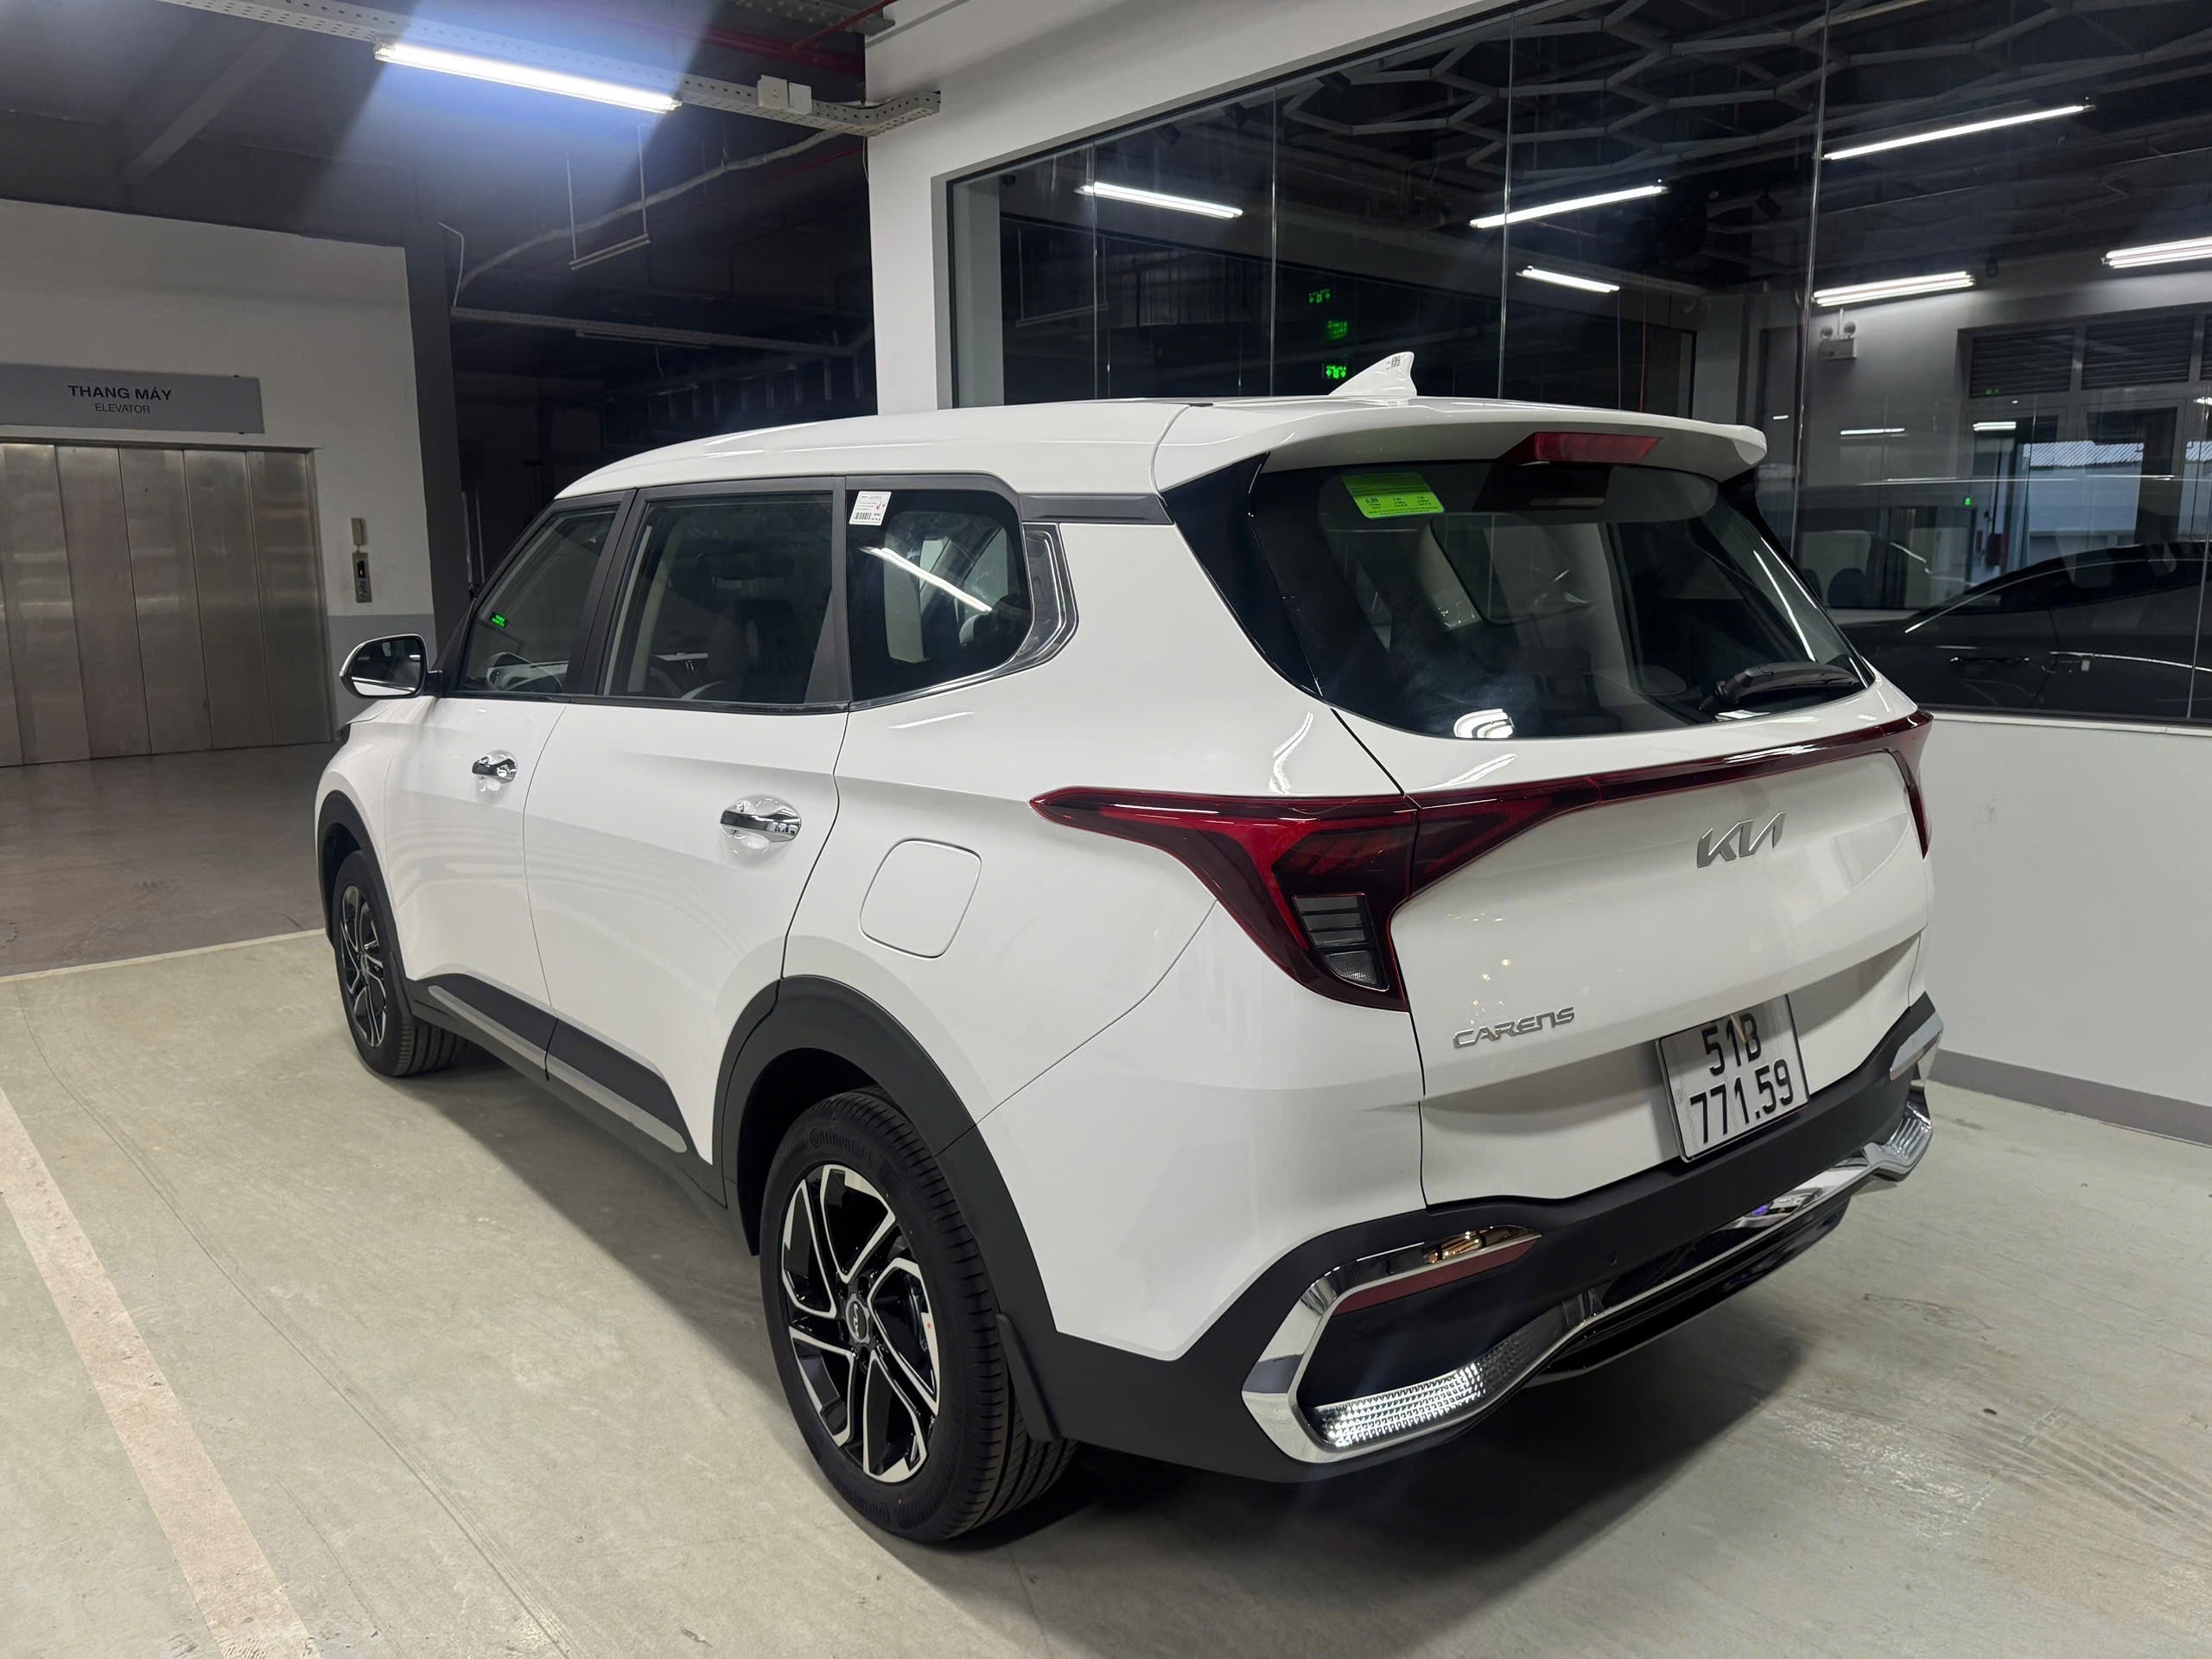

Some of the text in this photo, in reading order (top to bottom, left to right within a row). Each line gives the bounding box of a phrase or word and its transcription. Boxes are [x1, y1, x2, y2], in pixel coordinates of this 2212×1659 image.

[67, 385, 172, 401] THANG MÁY
[94, 403, 151, 414] ELEVATOR
[1696, 810, 1787, 868] KIA
[1452, 1007, 1575, 1049] CARENS
[1704, 1012, 1762, 1077] 51B
[1689, 1058, 1794, 1144] 771.59
